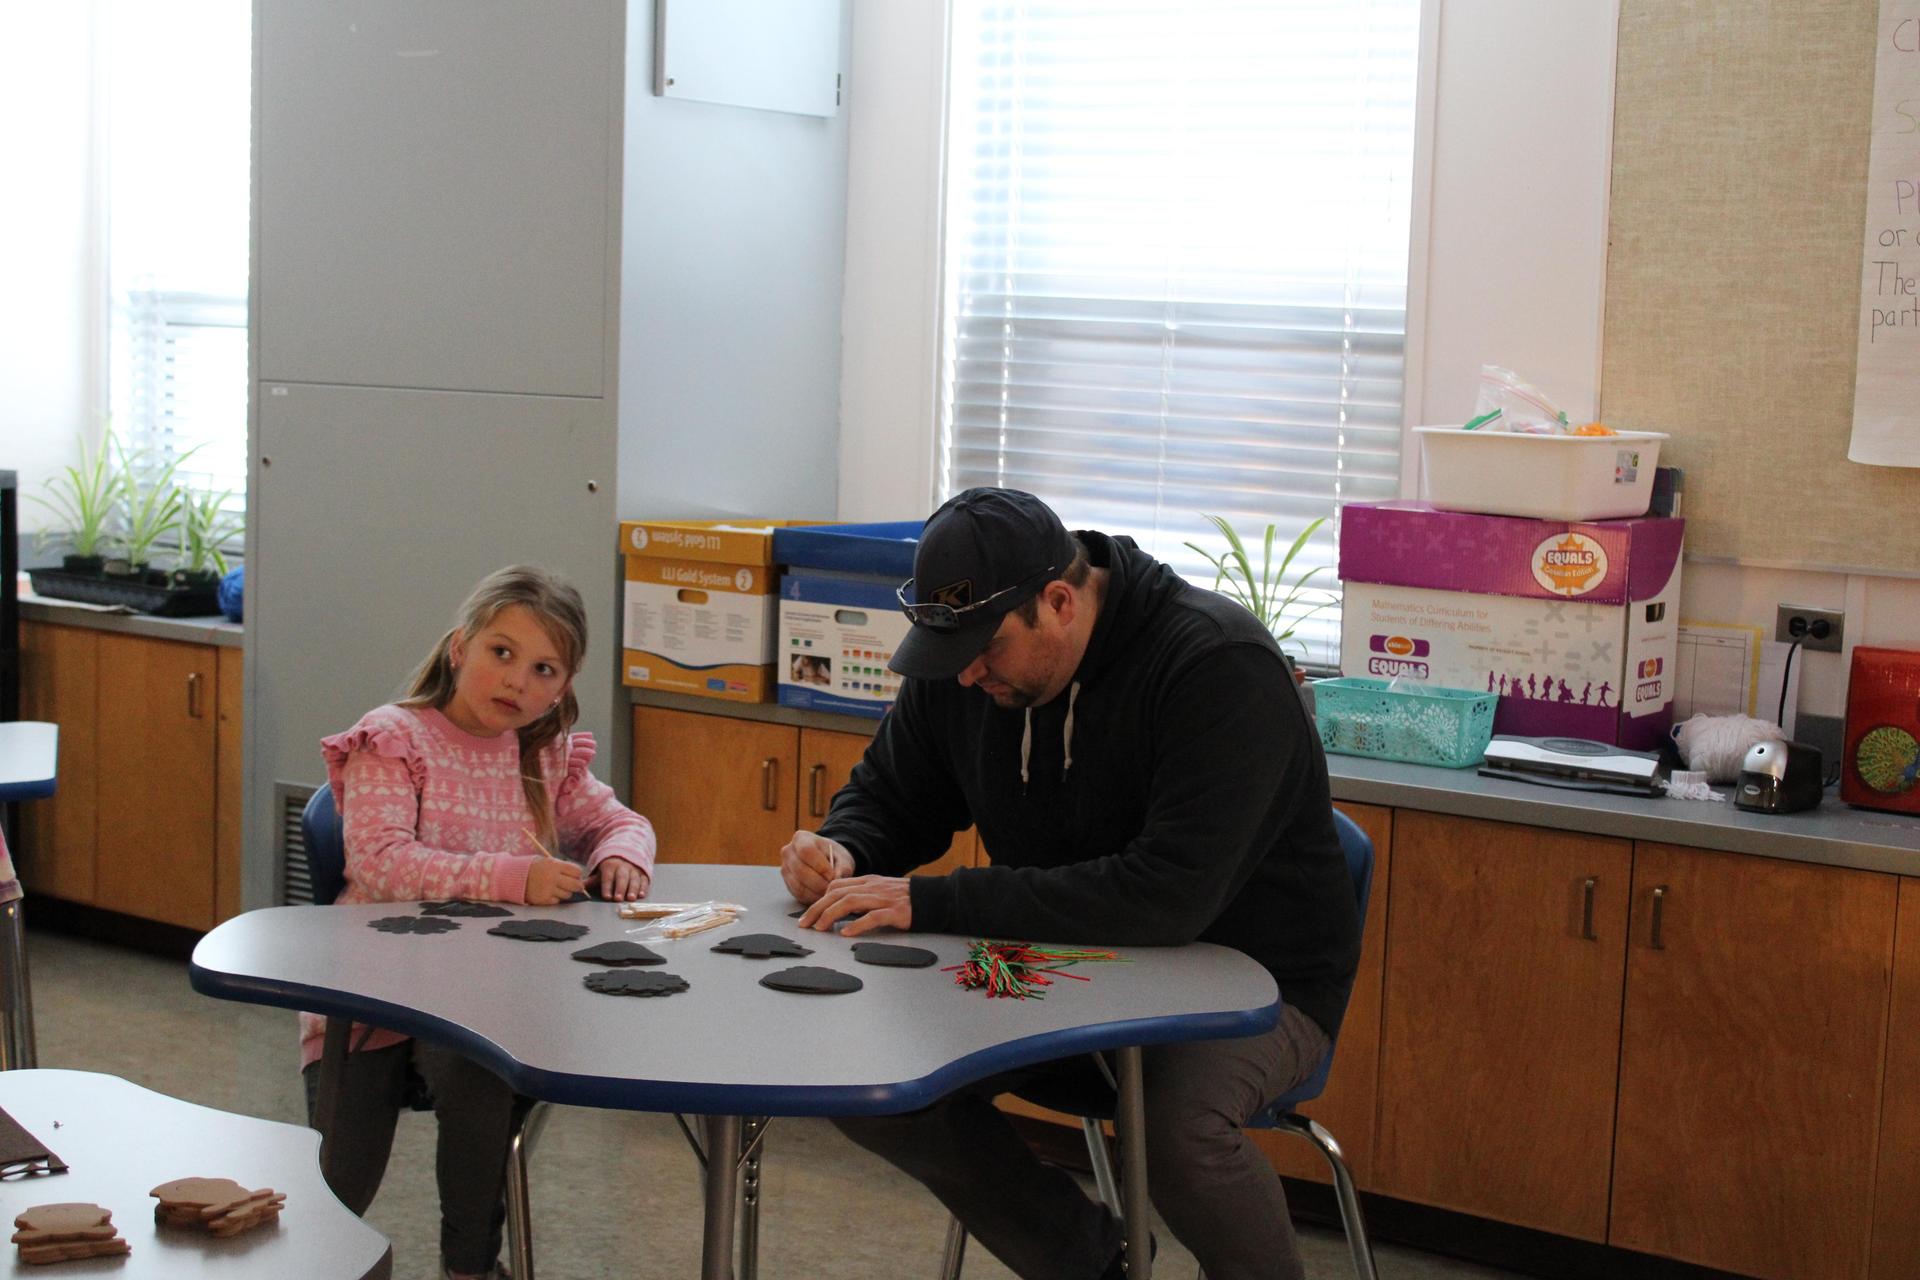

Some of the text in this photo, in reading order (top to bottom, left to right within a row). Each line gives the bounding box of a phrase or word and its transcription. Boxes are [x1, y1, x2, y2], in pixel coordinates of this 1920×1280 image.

[1895, 99, 1920, 134] S
[1878, 228, 1907, 247] or
[1871, 260, 1917, 296] The
[651, 530, 684, 546] System
[684, 534, 706, 549] Gold
[1547, 551, 1593, 566] EQUALS
[676, 568, 698, 582] Gold
[699, 570, 732, 587] System
[740, 575, 747, 590] 2
[1371, 599, 1489, 619] Mathematics Curriculum for
[1370, 612, 1493, 633] Students of Differing Abilities
[1370, 659, 1428, 679] EQUALS
